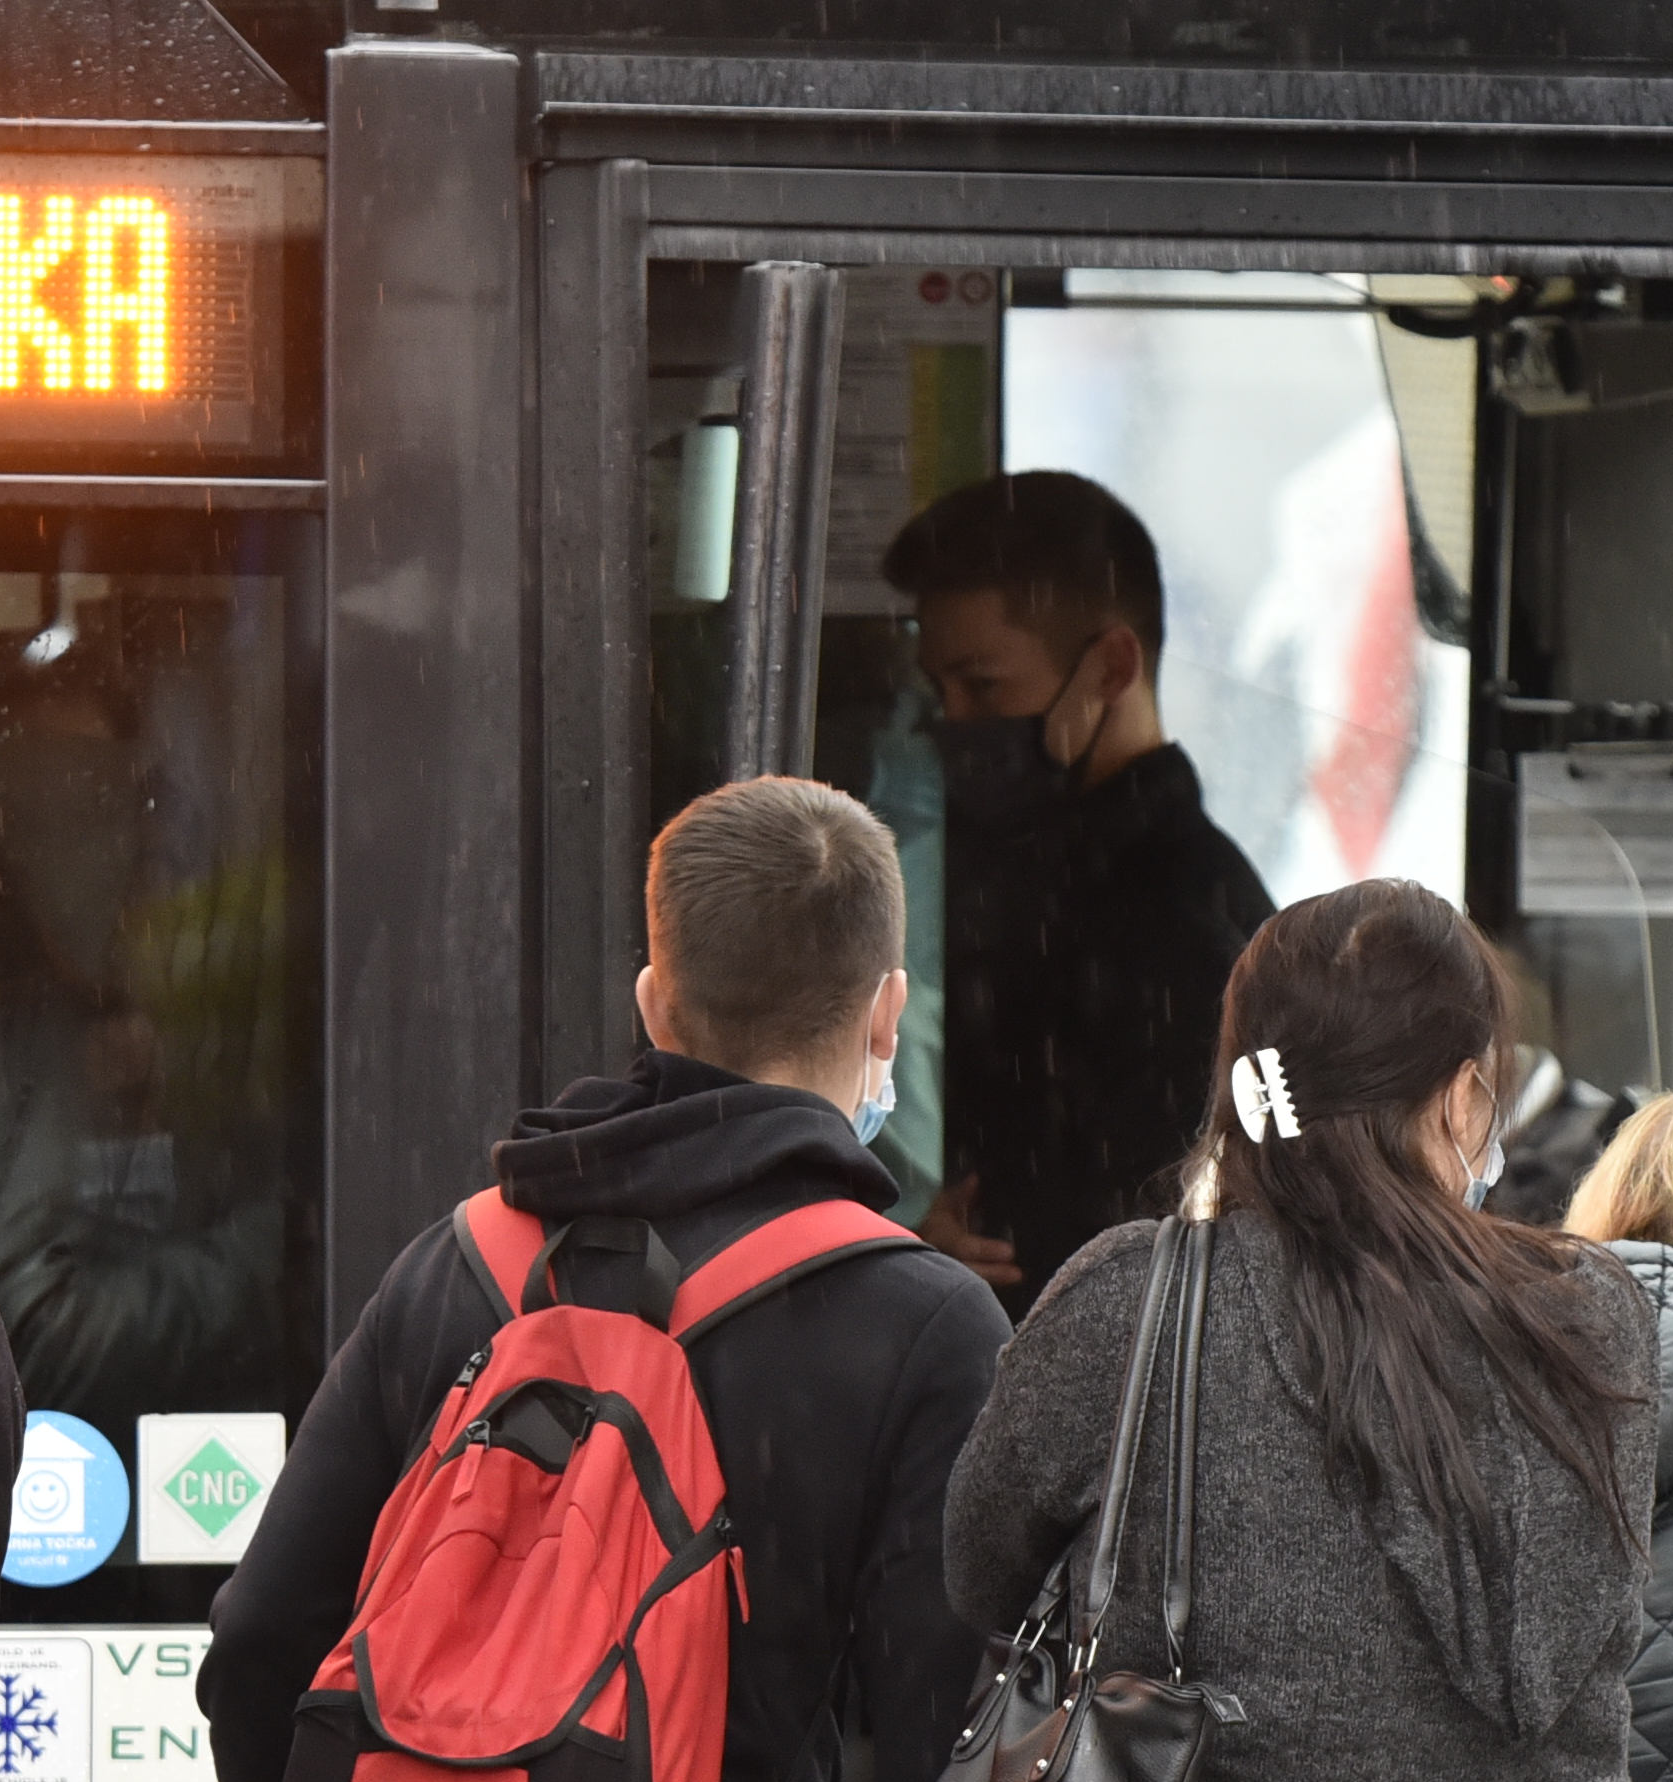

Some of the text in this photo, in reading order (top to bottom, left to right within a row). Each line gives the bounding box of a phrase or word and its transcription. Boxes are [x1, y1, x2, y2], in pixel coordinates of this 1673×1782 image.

[178, 1468, 249, 1506] CNG
[106, 1642, 214, 1677] VS
[110, 1724, 199, 1761] EN
